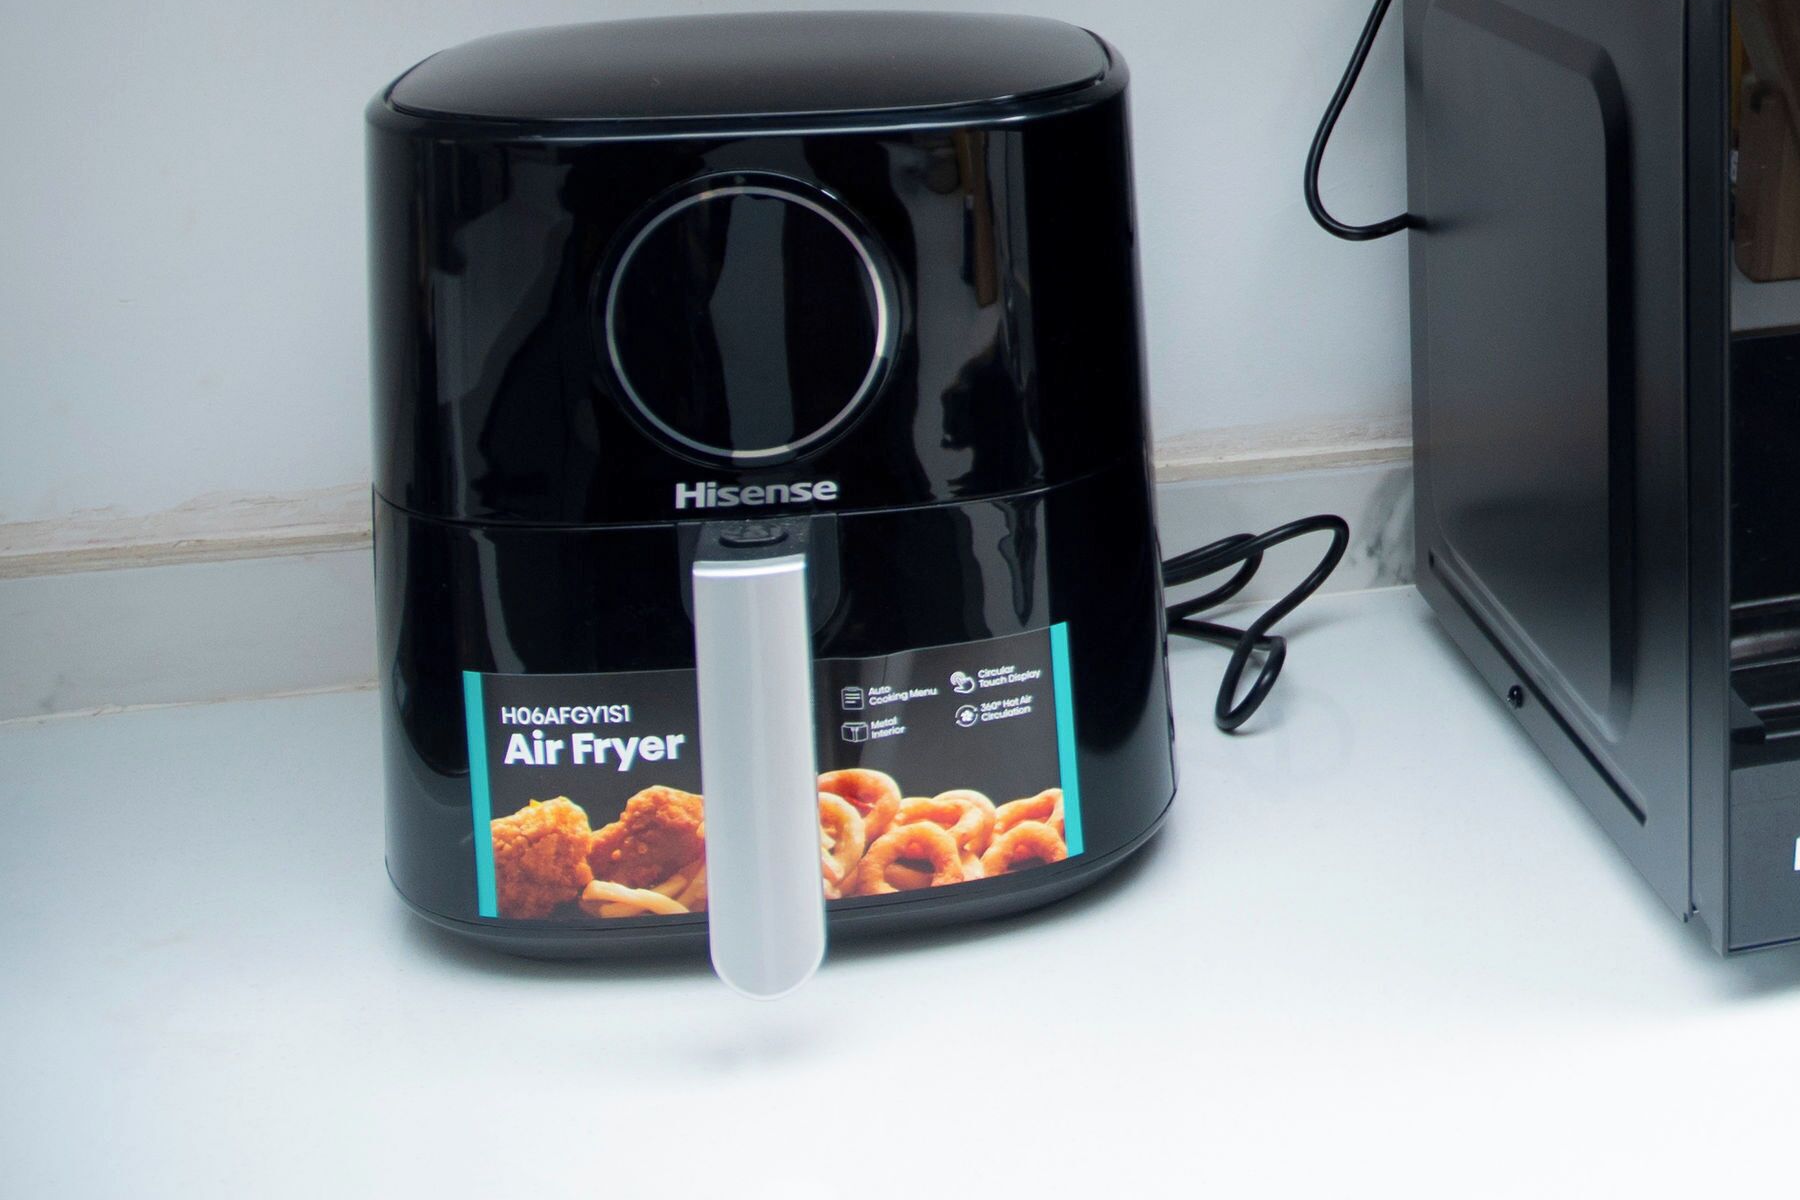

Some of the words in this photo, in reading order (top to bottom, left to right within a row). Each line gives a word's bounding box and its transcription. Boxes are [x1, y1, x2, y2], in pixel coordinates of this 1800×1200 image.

[675, 480, 838, 509] Hisense
[977, 665, 1015, 679] Circular
[979, 675, 1007, 688] Touch
[1008, 669, 1041, 685] Display
[868, 685, 892, 696] Auto
[868, 691, 909, 706] Cooking
[910, 687, 938, 698] Menu
[1002, 696, 1019, 708] Hot
[1020, 694, 1033, 705] Air
[501, 704, 631, 725] H06AFGY1S1
[981, 705, 1031, 722] Circulation
[871, 717, 897, 730] Metal
[871, 725, 905, 740] Interior
[503, 729, 564, 765] Air
[572, 732, 686, 772] Fryer
